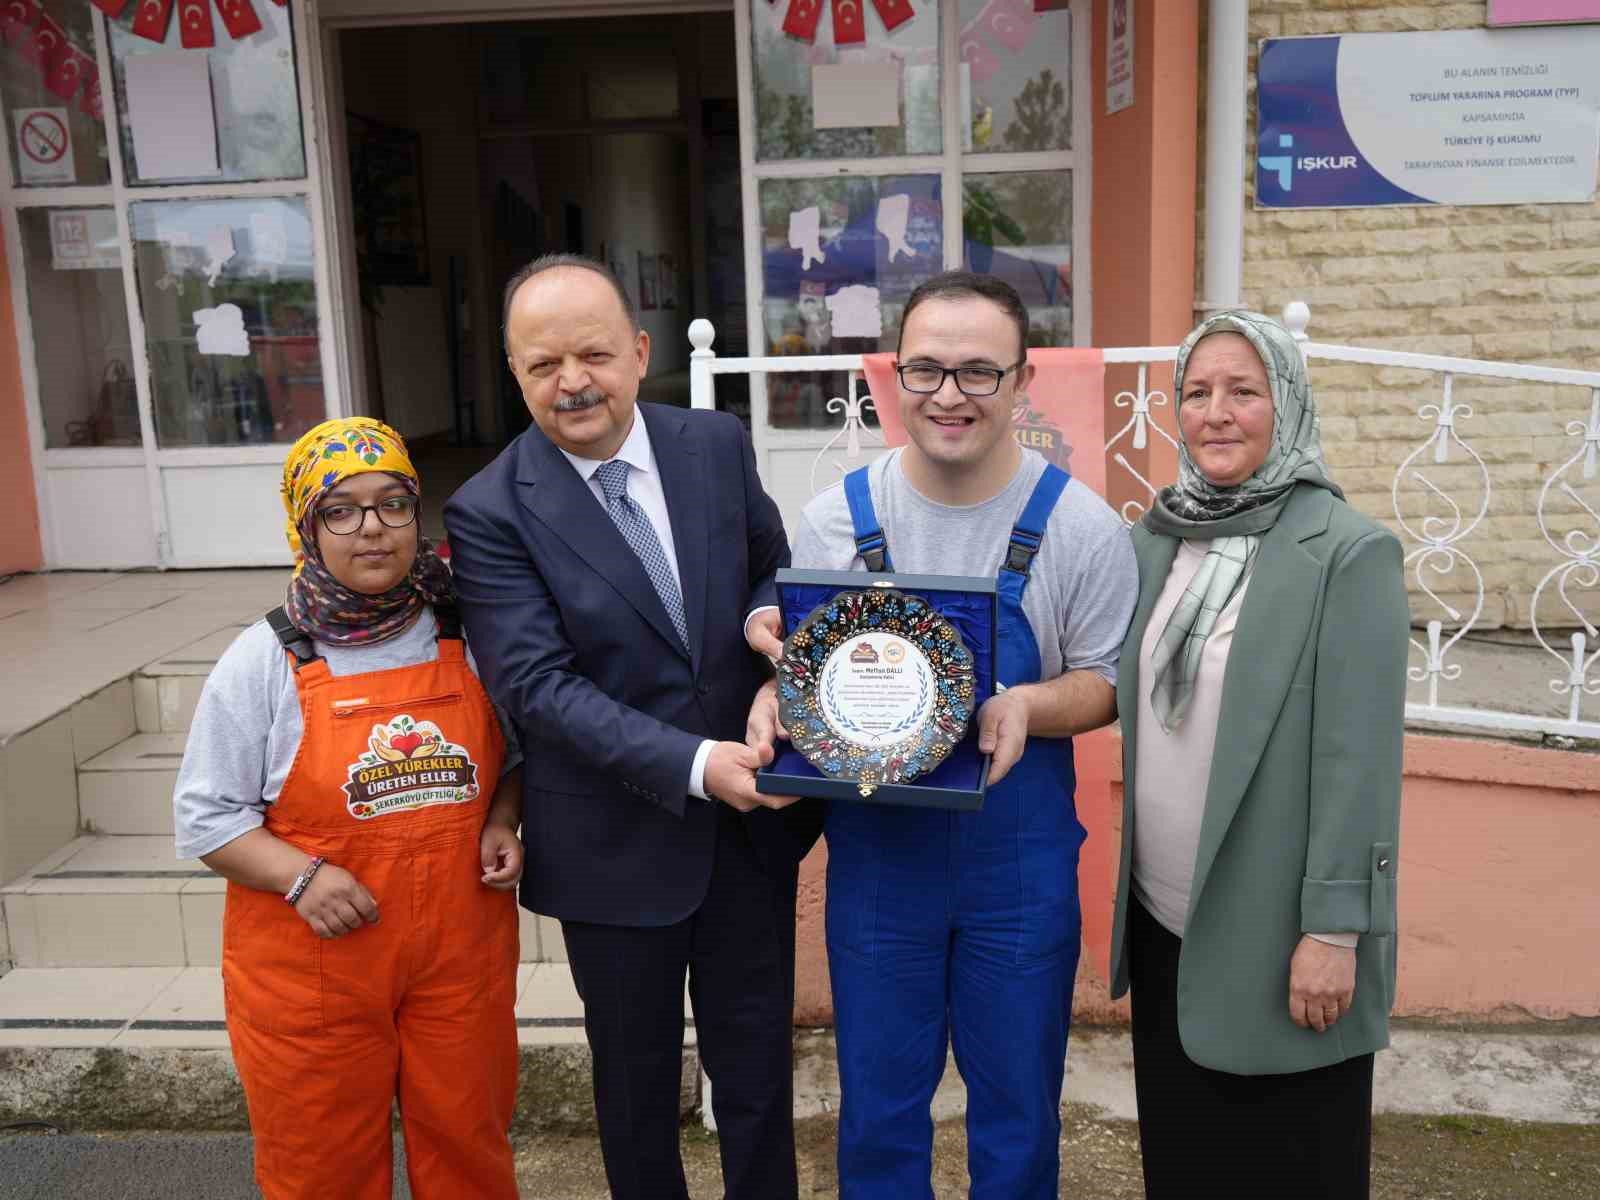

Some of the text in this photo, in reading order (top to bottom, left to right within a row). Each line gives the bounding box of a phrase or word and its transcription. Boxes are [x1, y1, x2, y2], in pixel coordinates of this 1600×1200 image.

[1443, 68, 1458, 78] BU
[1461, 67, 1497, 78] ALANIN
[1409, 92, 1450, 102] TOPLUM
[1503, 88, 1553, 99] PROGRAM
[1444, 135, 1483, 146] TÜRKİYE
[1497, 134, 1542, 144] KURUMU
[1010, 430, 1054, 449] KLER
[359, 758, 463, 784] ÖZEL YÜREKLER
[367, 771, 457, 796] ÜRETEN ELLER
